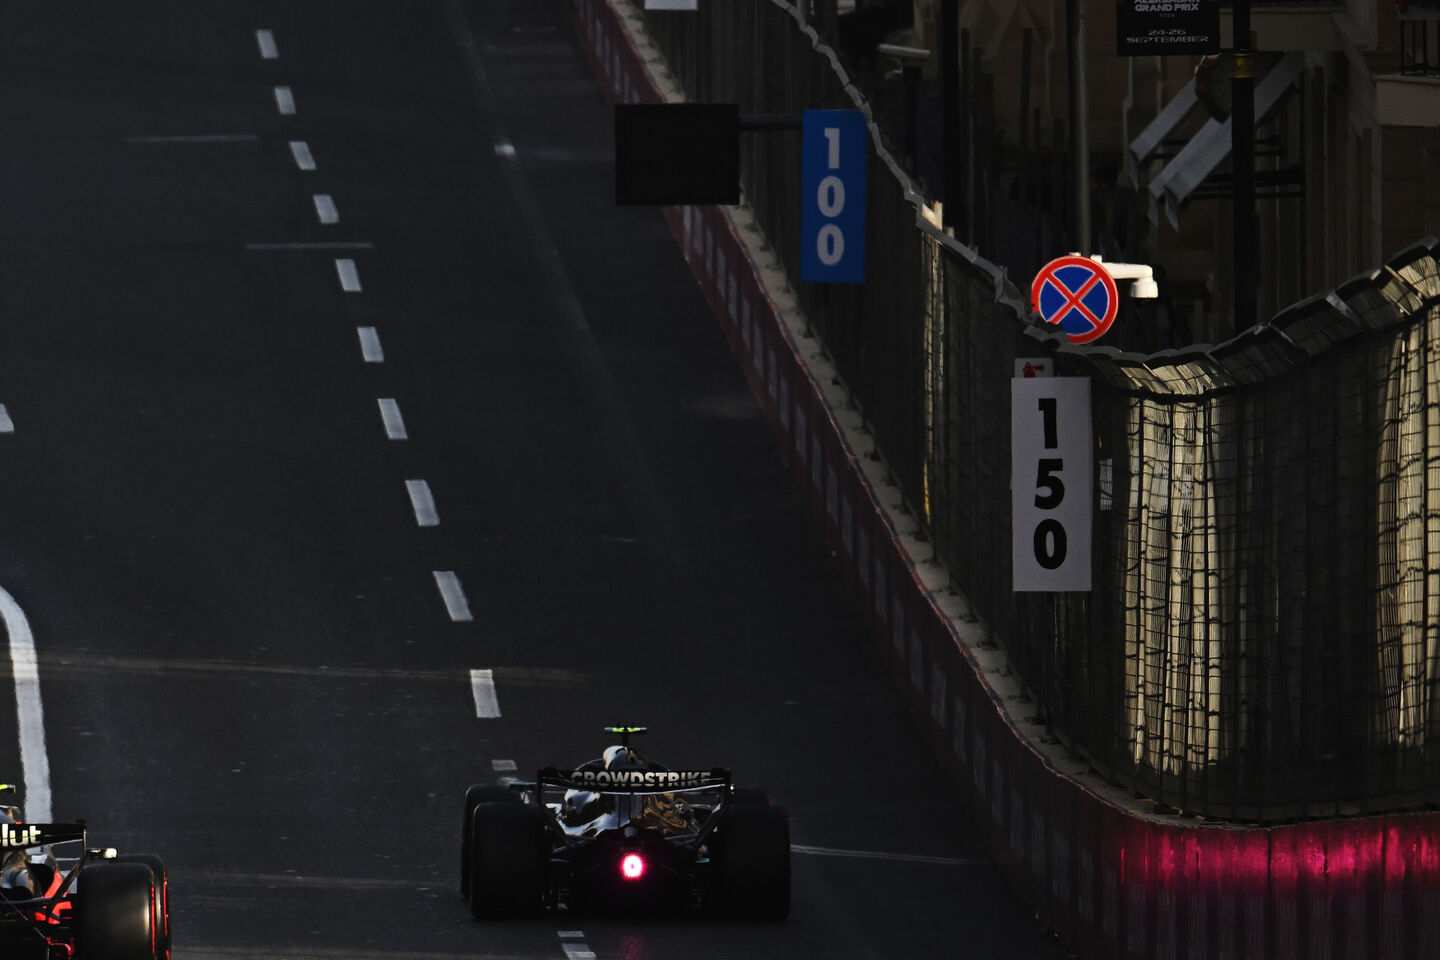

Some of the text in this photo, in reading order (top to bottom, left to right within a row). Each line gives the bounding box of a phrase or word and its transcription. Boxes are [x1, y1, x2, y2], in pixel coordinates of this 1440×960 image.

[1134, 3, 1200, 12] GRAND PRIX
[1148, 28, 1187, 36] 24-26
[1126, 36, 1209, 44] SEPTEMBER
[816, 127, 846, 267] 100
[1033, 397, 1068, 570] 150
[570, 770, 712, 788] CROWDSTRIKE
